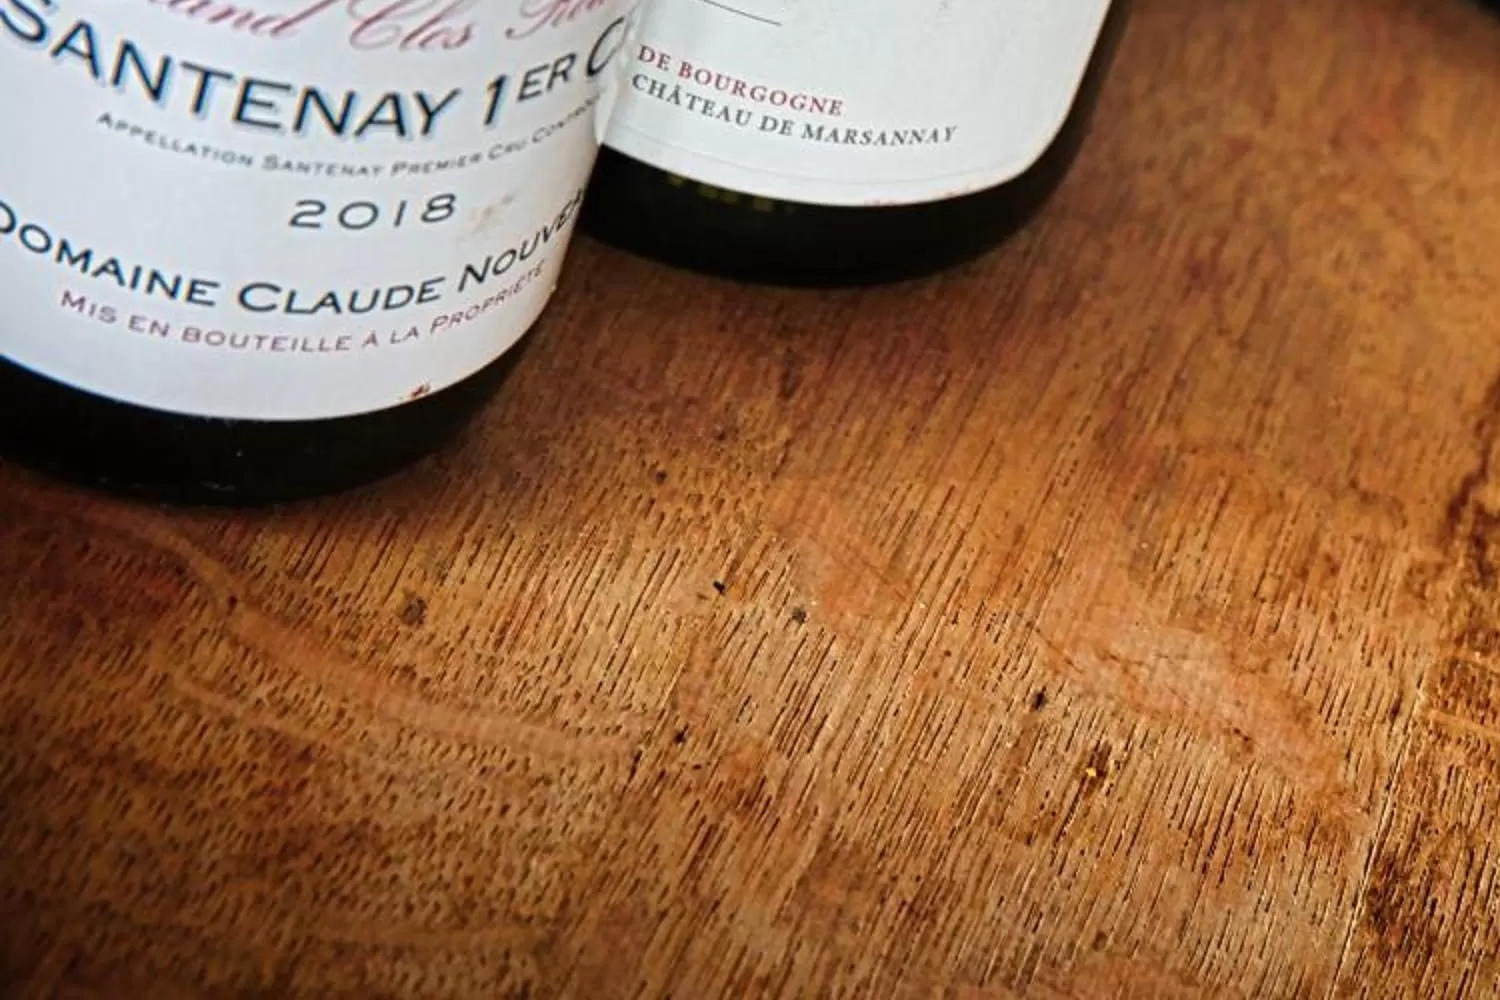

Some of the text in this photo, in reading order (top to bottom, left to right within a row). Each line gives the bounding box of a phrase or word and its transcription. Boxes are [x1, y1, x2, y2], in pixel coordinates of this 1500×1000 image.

[631, 73, 960, 146] CHÂTEAU DE MARSANNAY
[637, 43, 846, 118] DE BOURGOGNE
[288, 193, 457, 230] 2018
[60, 290, 118, 324] MIS
[128, 314, 170, 338] EN
[181, 326, 351, 355] BOUTEILLE
[390, 326, 419, 343] LA
[237, 276, 446, 316] CLAUDE
